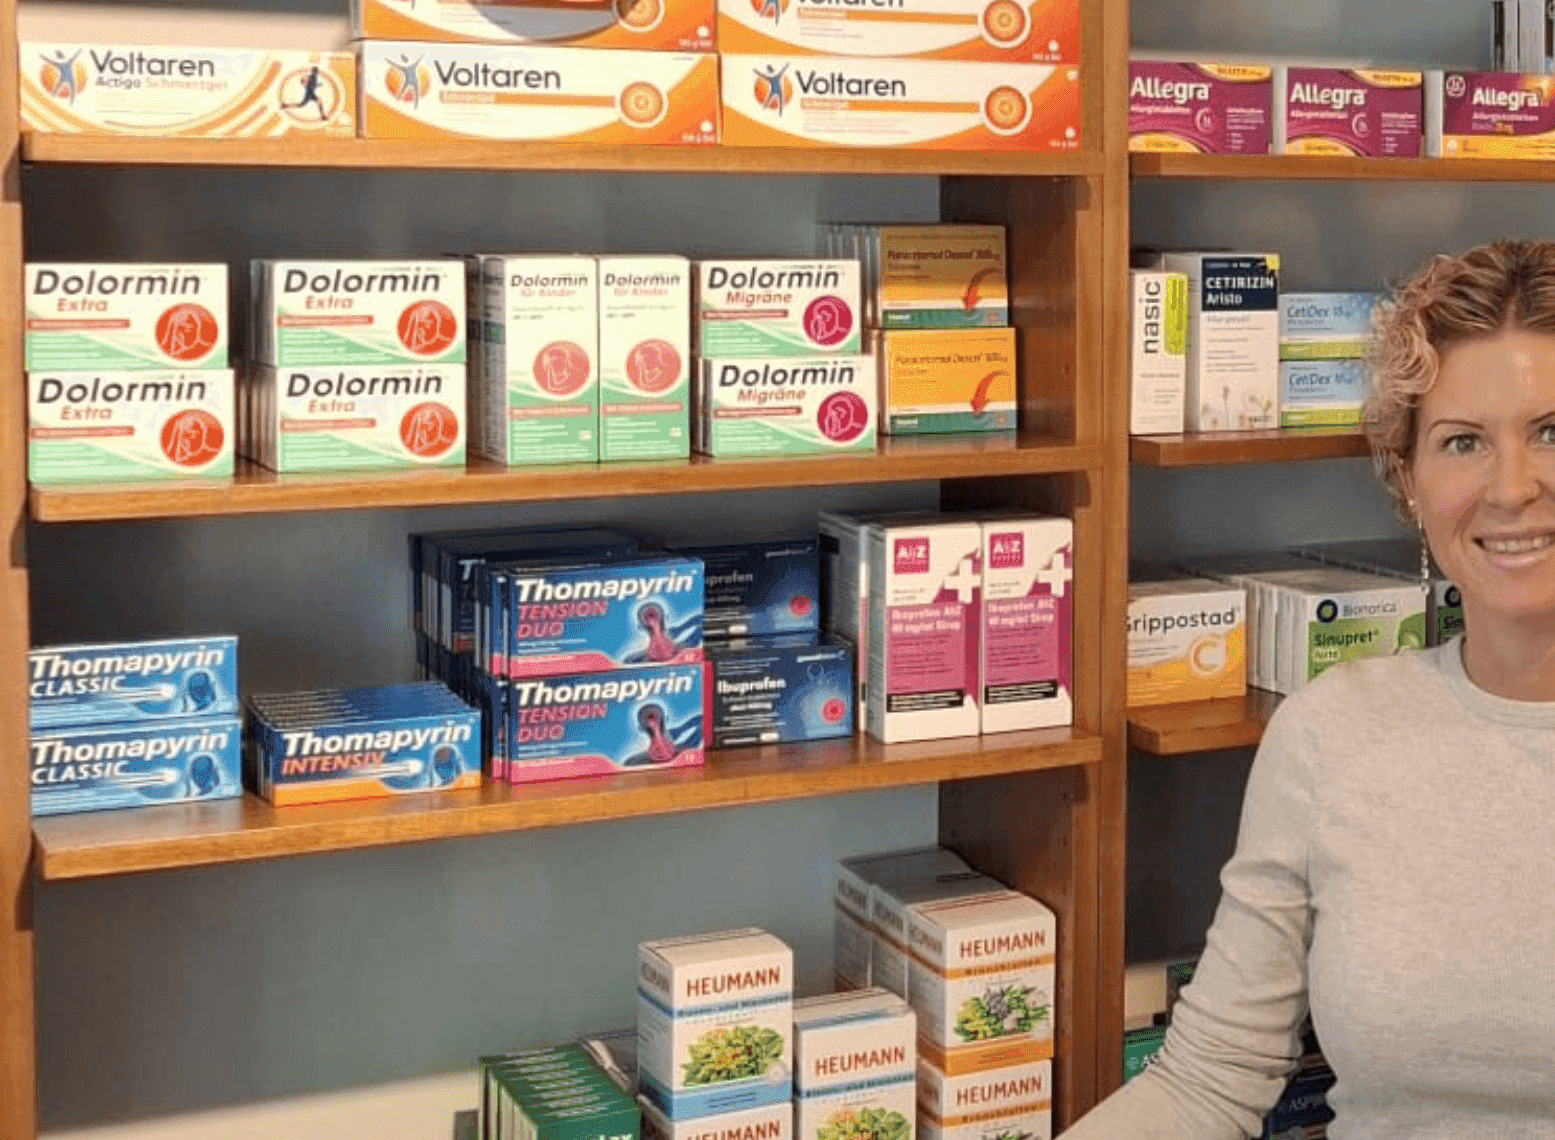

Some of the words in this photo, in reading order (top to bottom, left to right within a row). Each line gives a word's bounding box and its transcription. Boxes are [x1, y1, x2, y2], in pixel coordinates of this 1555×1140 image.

[89, 49, 215, 78] Voltaren
[434, 60, 562, 90] Voltaren
[796, 70, 906, 97] Voltaren
[1130, 76, 1209, 105] Allegra
[1290, 82, 1365, 109] Allegra
[1472, 88, 1539, 111] Allegra
[34, 268, 201, 295] Dolormin
[283, 267, 440, 294] Dolormin
[510, 274, 589, 288] Dolormin
[604, 272, 680, 287] Dolormin
[707, 264, 840, 290] Dolormin
[1205, 277, 1275, 290] CETIRIZIN
[56, 298, 109, 312] Extra
[305, 296, 354, 310] Extra
[725, 290, 793, 307] Migräne
[1206, 293, 1243, 305] Aristo
[1142, 280, 1161, 354] nasic
[286, 370, 442, 397] Dolormin
[719, 362, 855, 387] Dolormin
[37, 374, 206, 404] Dolormin
[737, 388, 806, 404] Migräne
[59, 405, 112, 421] Extra
[308, 399, 356, 413] Extra
[516, 570, 692, 603] Thomapyrin
[518, 601, 607, 620] TENSION
[1342, 602, 1397, 617] Bionorica
[517, 621, 564, 639] DUO
[1313, 630, 1374, 649] Sinupret
[29, 645, 225, 679] Thomapyrin
[30, 675, 126, 697] CLASSIC
[516, 672, 692, 706] Thomapyrin
[717, 676, 786, 695] Ibuprofen
[518, 703, 607, 724] TENSION
[282, 720, 471, 757] Thomapyrin
[517, 724, 564, 743] DUO
[32, 728, 228, 765] Thomapyrin
[32, 760, 129, 784] CLASSIC
[281, 751, 385, 776] INTENSIV
[960, 929, 1046, 959] HEUMANN
[686, 966, 780, 998] HEUMANN
[814, 1045, 906, 1077] HEUMANN
[956, 1074, 1042, 1106] HEUMANN
